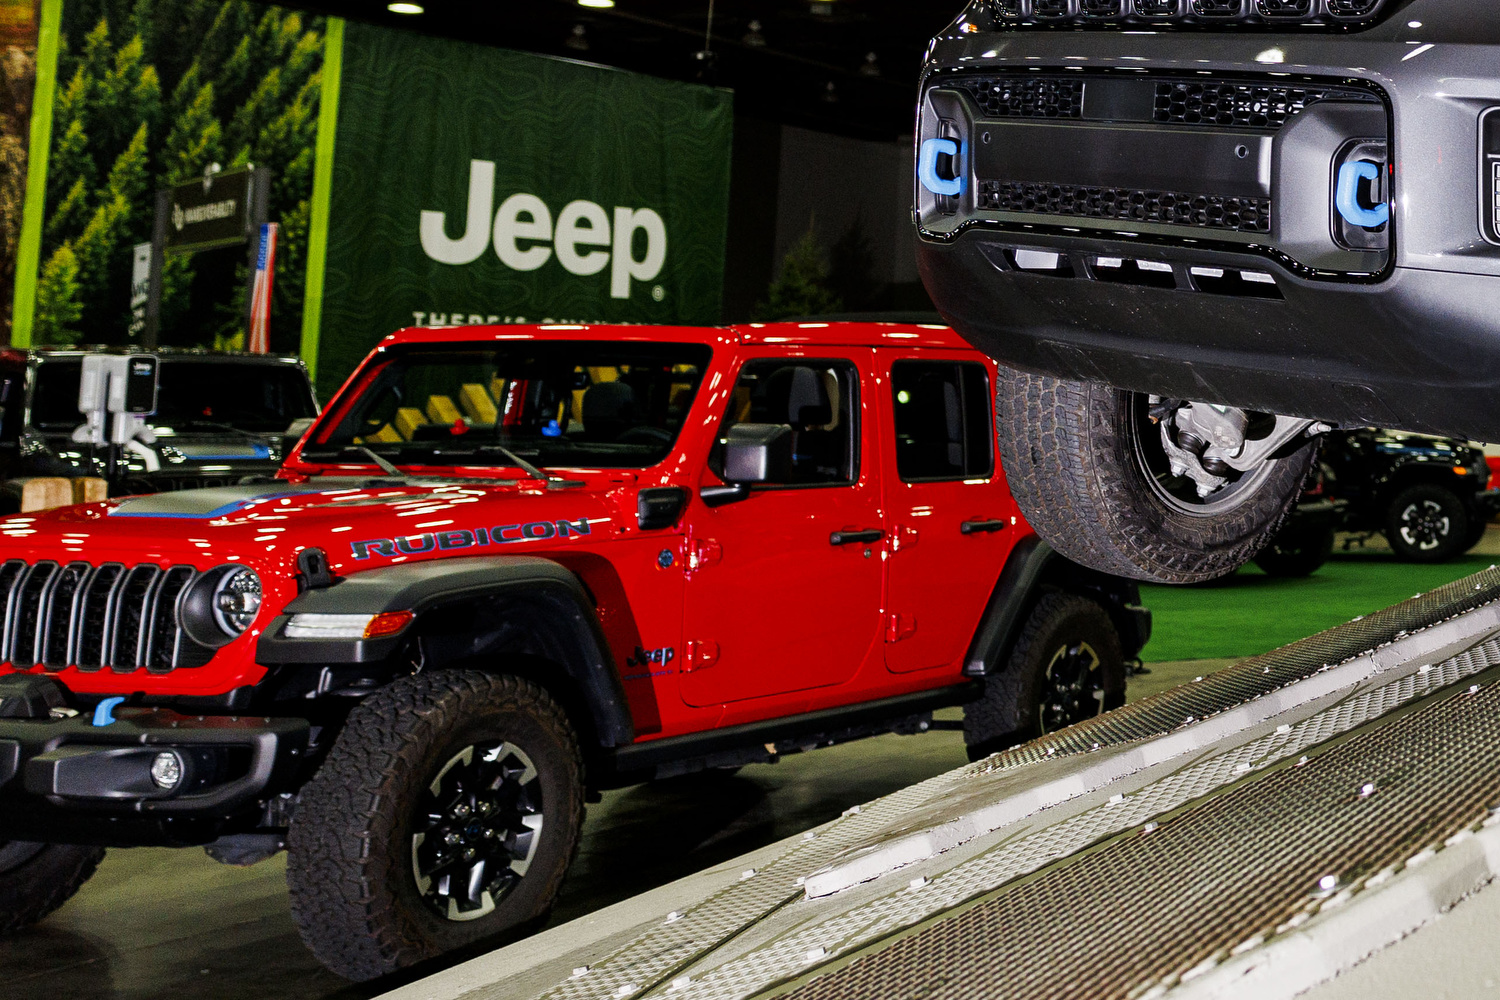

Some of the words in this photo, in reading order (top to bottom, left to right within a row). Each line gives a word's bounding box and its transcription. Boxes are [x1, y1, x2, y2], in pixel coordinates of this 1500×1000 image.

[419, 158, 667, 299] Jeep
[350, 517, 591, 560] RUBICON
[626, 645, 675, 668] Jeep
